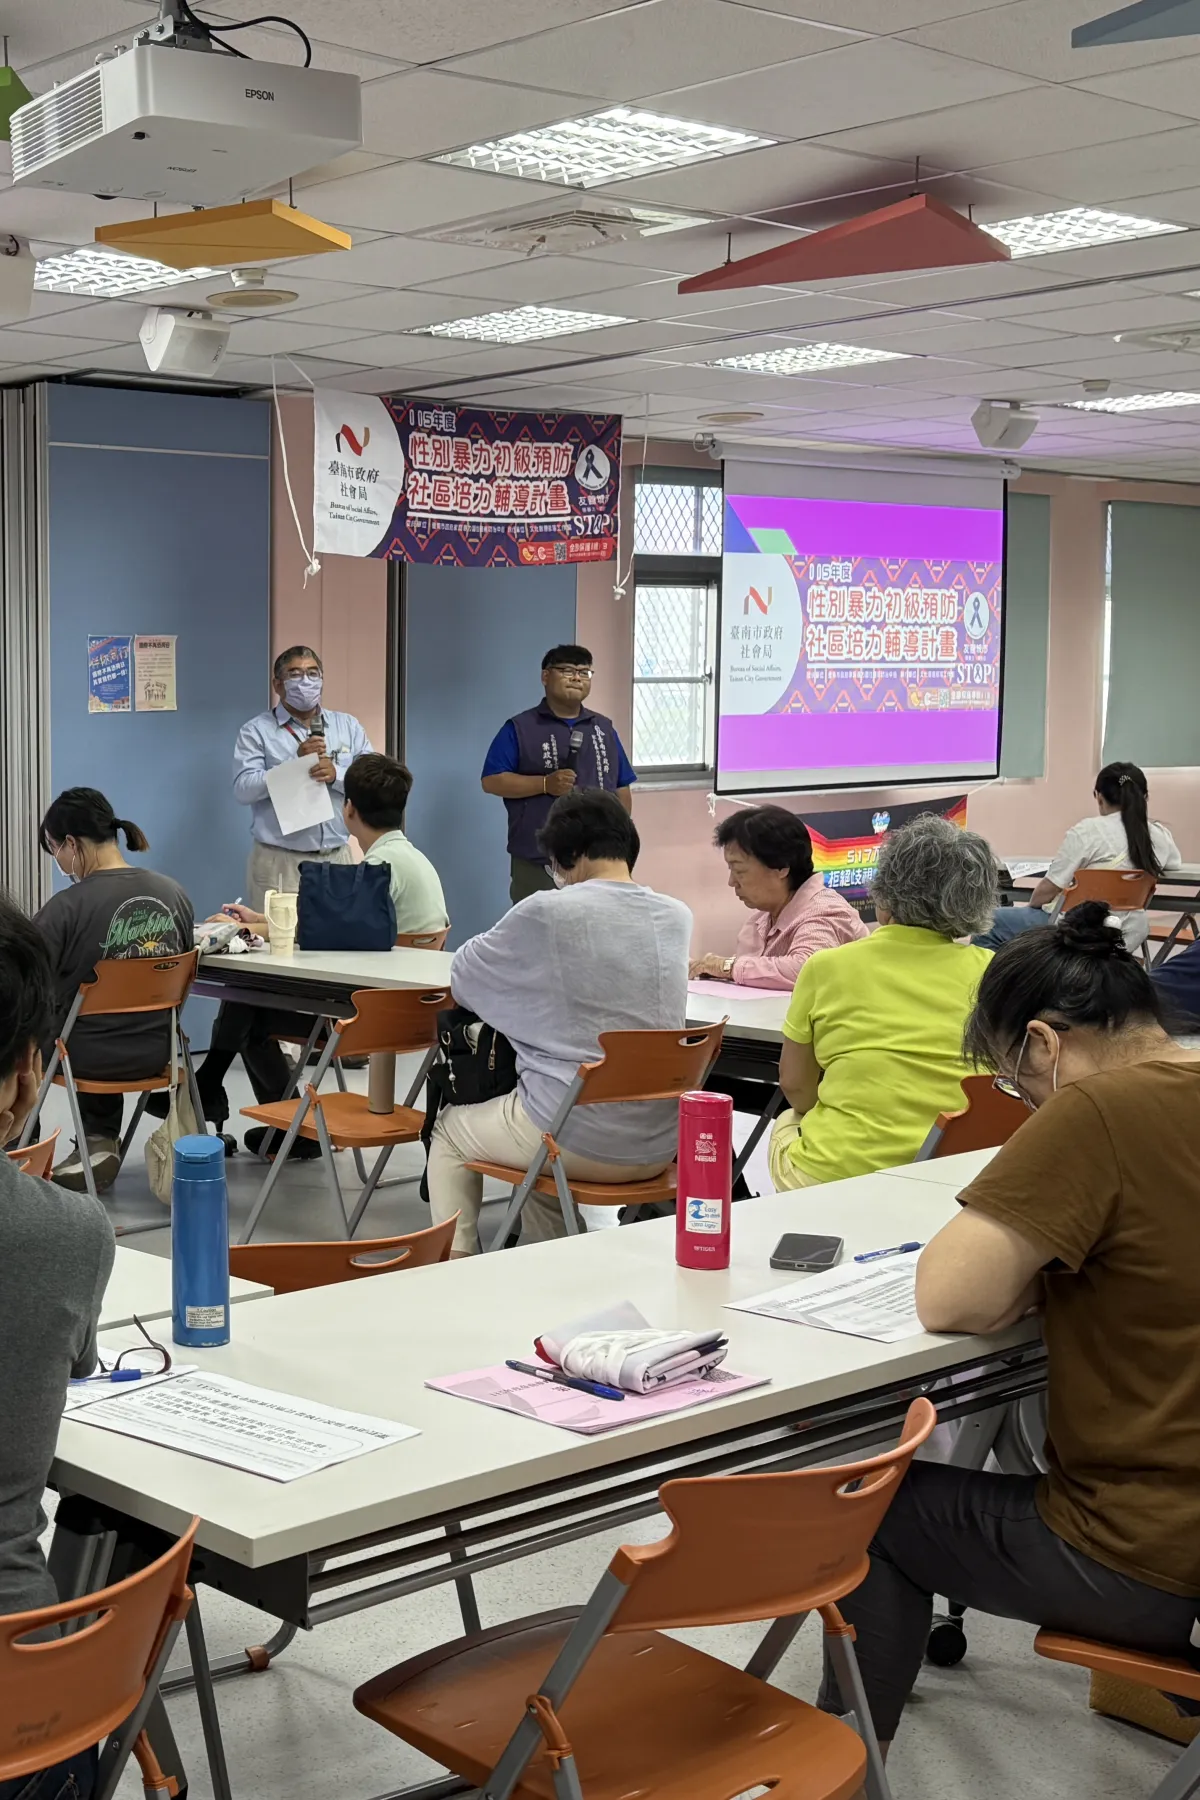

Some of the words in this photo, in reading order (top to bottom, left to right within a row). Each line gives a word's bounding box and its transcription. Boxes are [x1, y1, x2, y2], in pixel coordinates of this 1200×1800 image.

[245, 88, 275, 102] EPSON
[409, 409, 456, 432] 115年度
[410, 433, 572, 476] 性別暴力初級預防
[408, 474, 569, 513] 社區培力輔導計畫
[574, 514, 610, 536] STOP
[810, 562, 852, 582] 115年度
[808, 587, 957, 621] 性別暴力初級預防
[730, 625, 783, 640] 臺南市政府
[807, 627, 957, 659] 社區培力輔導計畫
[740, 644, 772, 659] 社會局
[957, 663, 992, 684] STOP
